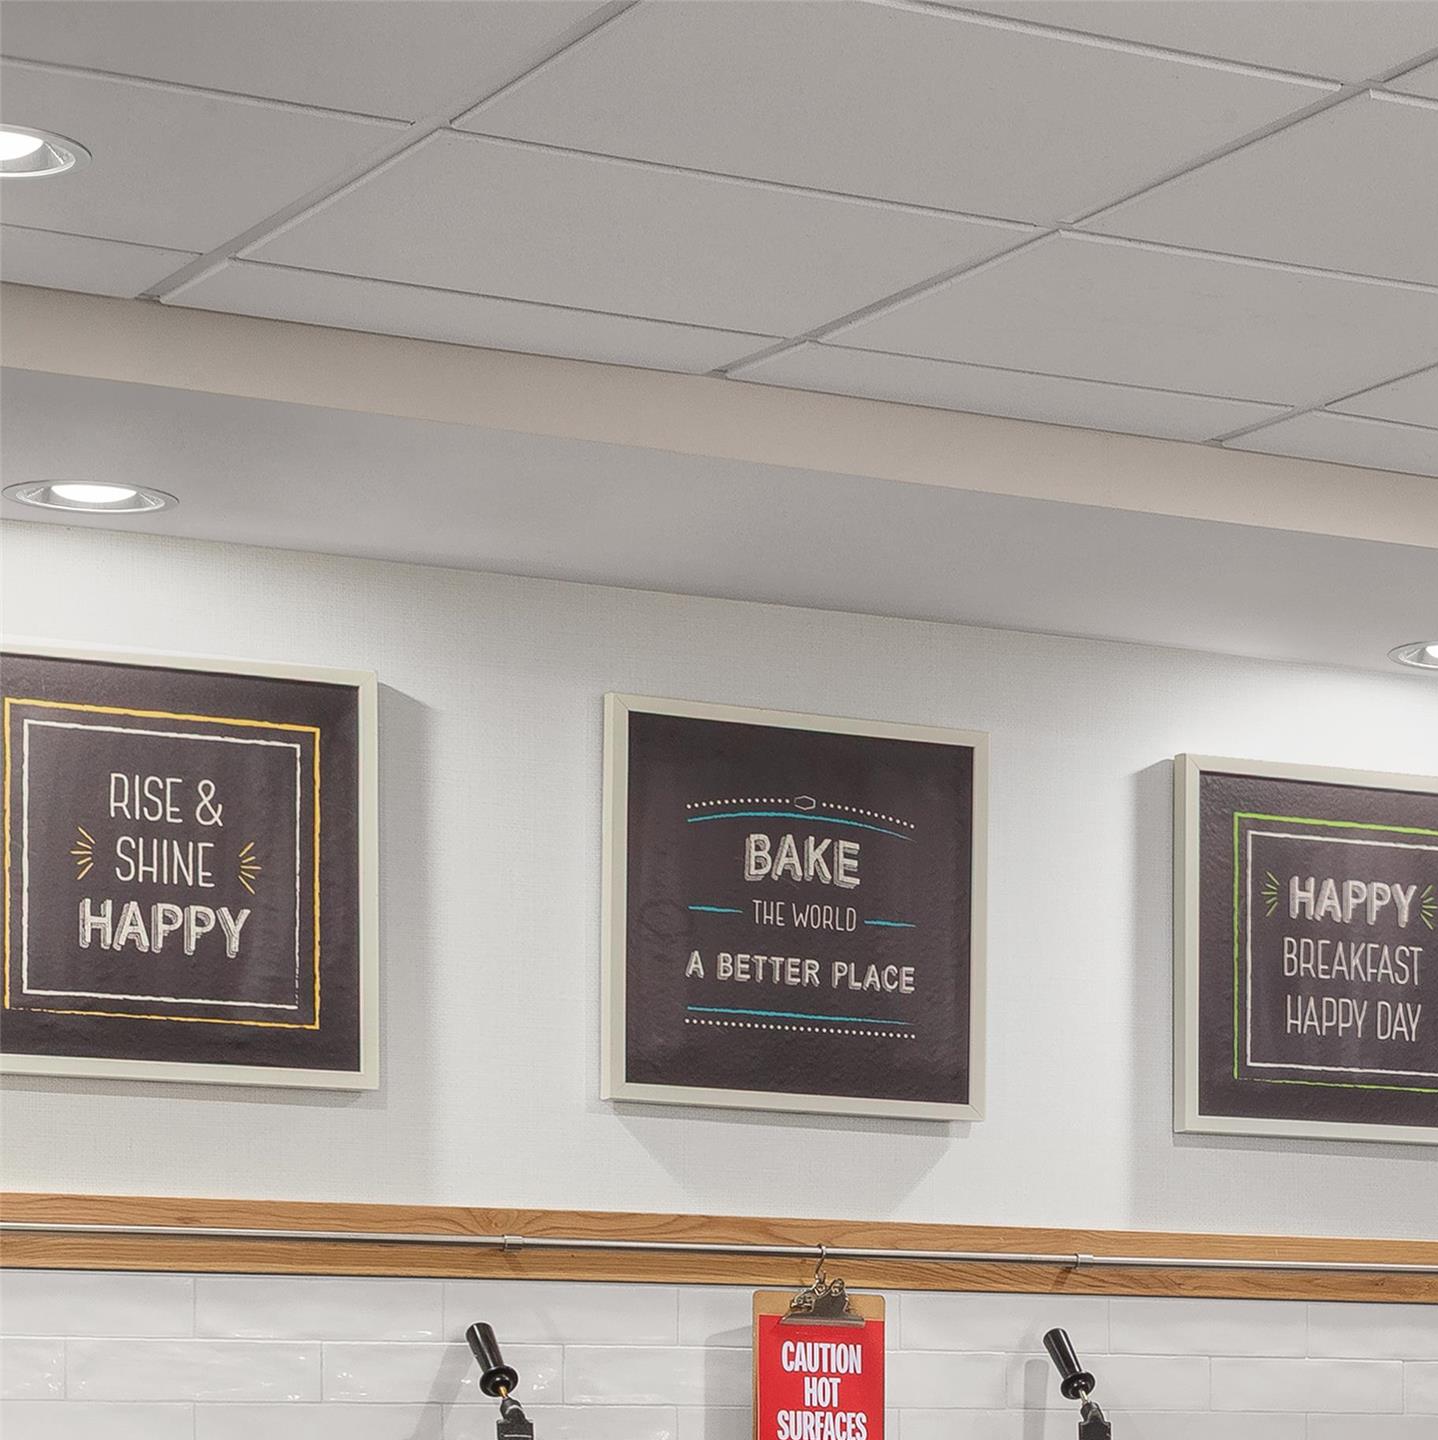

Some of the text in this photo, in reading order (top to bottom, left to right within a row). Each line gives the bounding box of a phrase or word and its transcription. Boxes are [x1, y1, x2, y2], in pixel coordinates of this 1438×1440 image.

[109, 772, 223, 827] RISE &
[115, 836, 215, 888] SHINE
[744, 833, 861, 889] BAKE
[752, 899, 857, 932] THE WORLD
[1289, 875, 1418, 928] HAPPY
[78, 898, 251, 959] HAPPY
[685, 950, 915, 994] A BETTER PLACE
[1283, 936, 1423, 986] BREAKFAST
[1286, 994, 1422, 1042] HAPPY DAY
[781, 1340, 863, 1374] CAUTION
[803, 1376, 841, 1408] HOT
